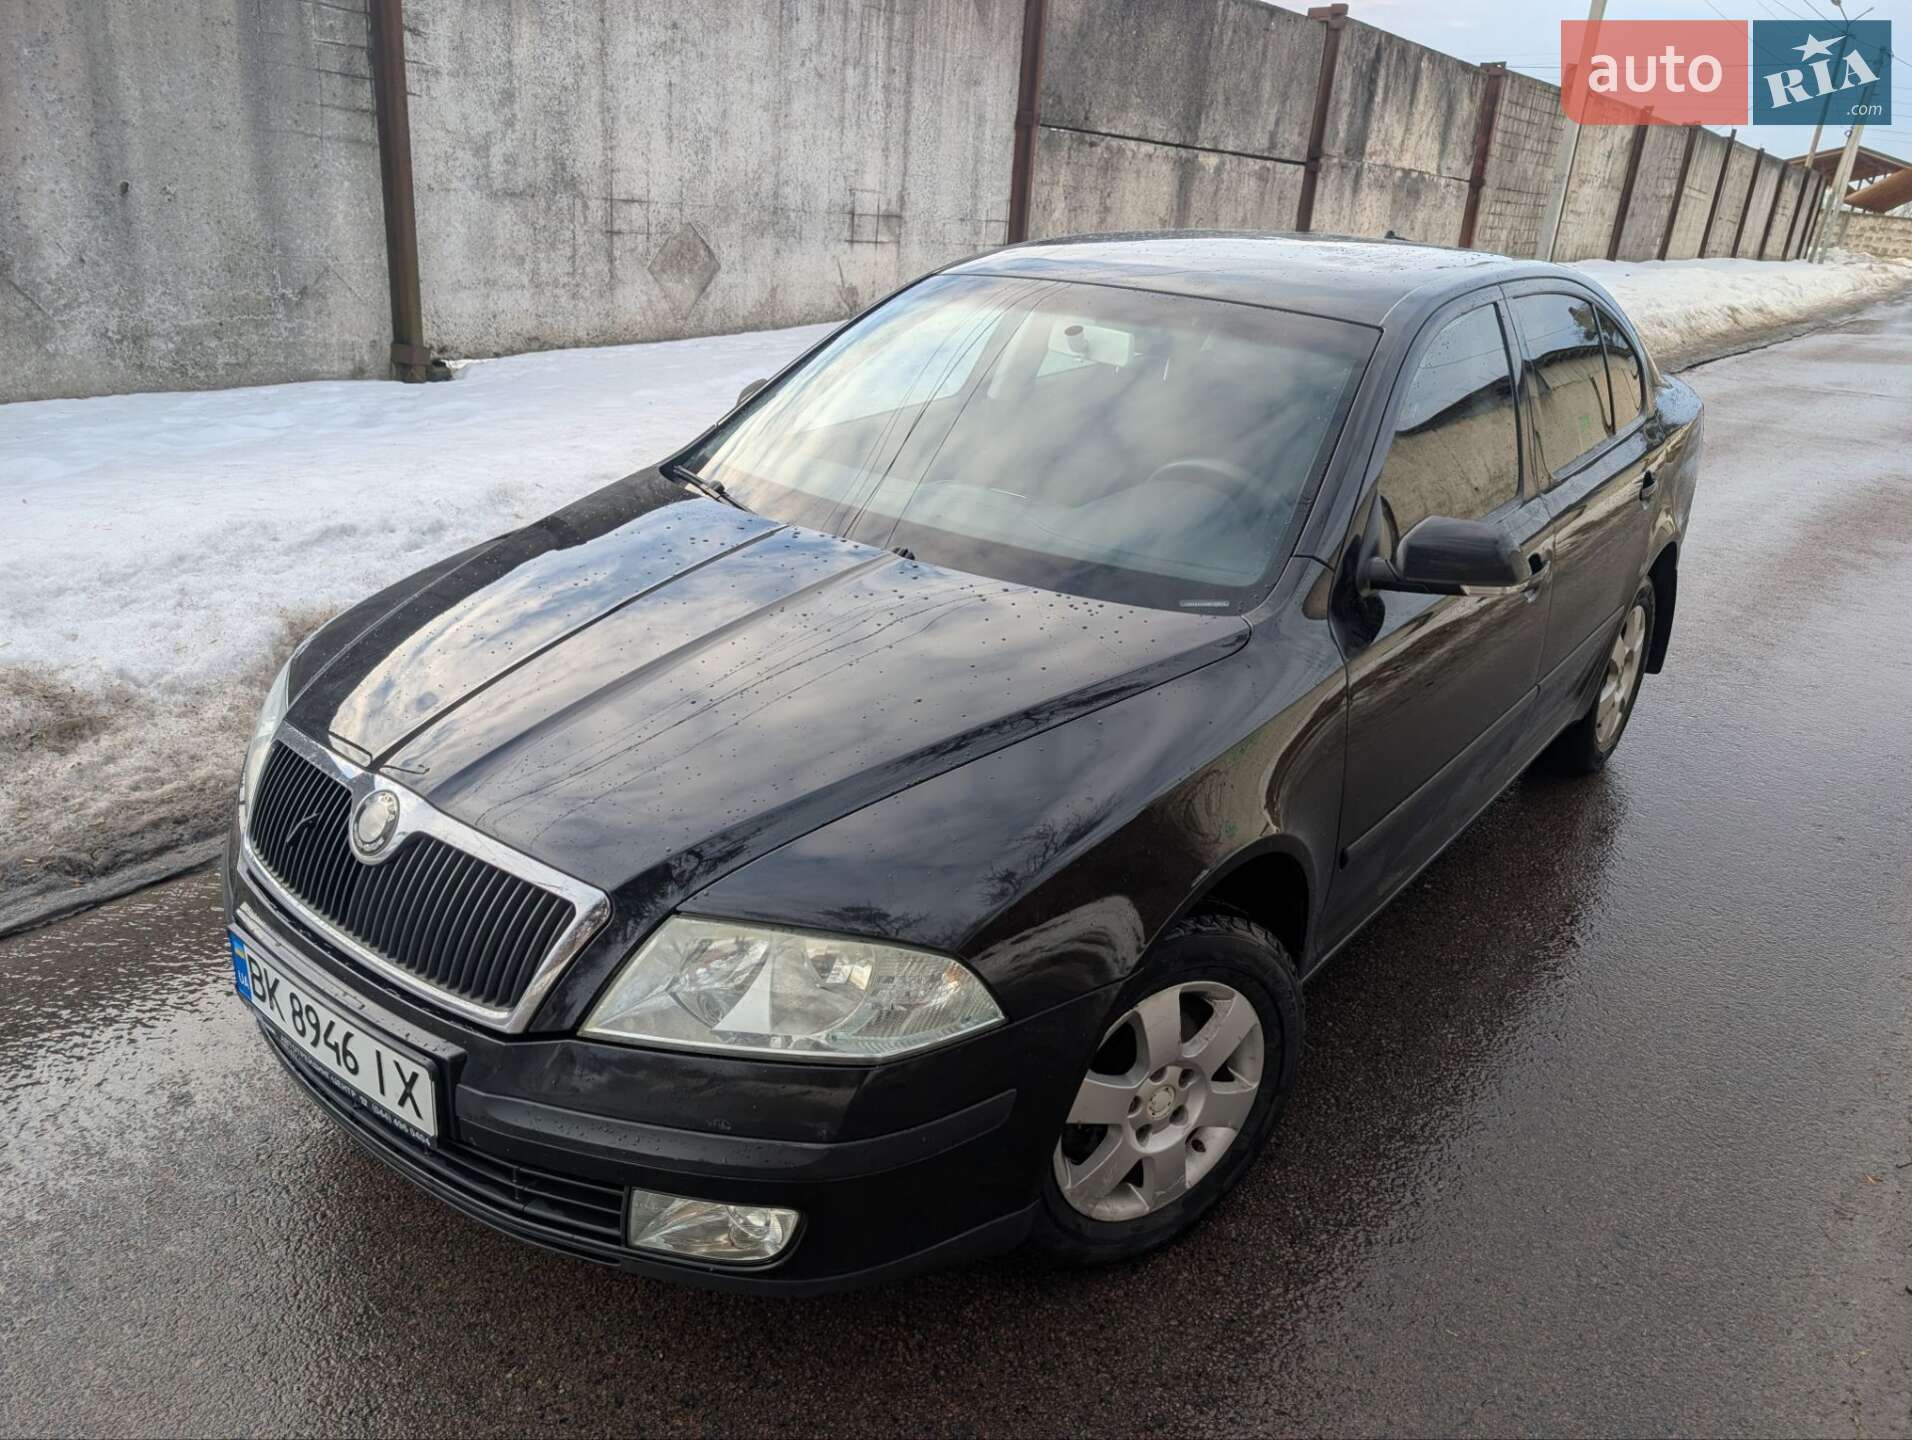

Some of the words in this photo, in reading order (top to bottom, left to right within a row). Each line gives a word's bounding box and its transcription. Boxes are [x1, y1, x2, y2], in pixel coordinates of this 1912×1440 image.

[248, 954, 286, 1022] BK
[289, 992, 360, 1076] 8946
[375, 1048, 424, 1121] IX
